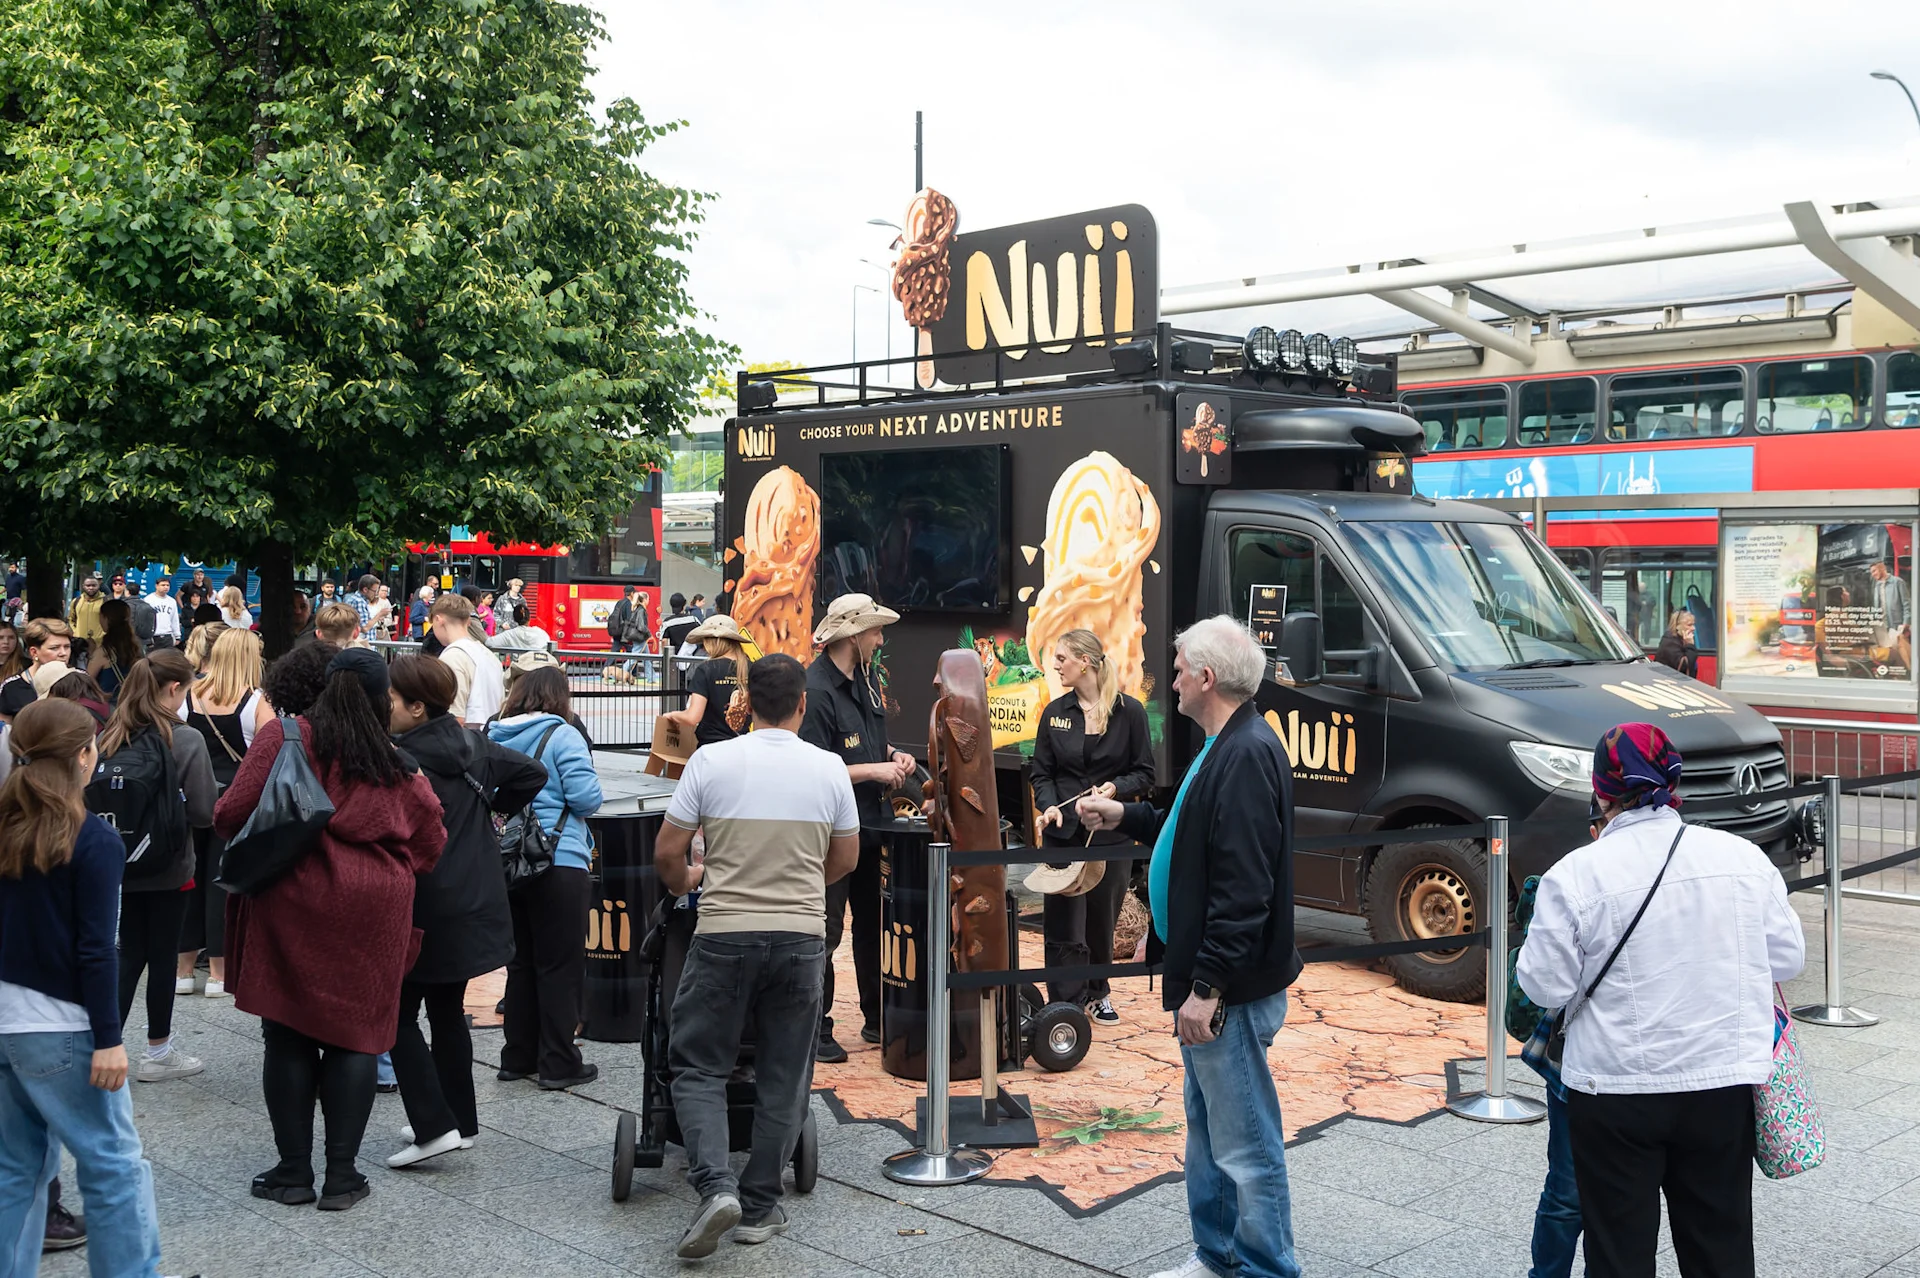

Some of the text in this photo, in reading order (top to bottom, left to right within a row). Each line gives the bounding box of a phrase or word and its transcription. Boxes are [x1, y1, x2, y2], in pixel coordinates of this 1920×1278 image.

[966, 221, 1134, 360] Nuii
[799, 405, 1063, 440] CHOOSE YOUR NEXT ADVENTURE
[738, 424, 776, 457] Nuii
[1865, 533, 1875, 549] 5
[154, 605, 173, 615] NYC
[1600, 678, 1733, 711] Nuii
[1021, 699, 1027, 707] &
[989, 708, 1026, 722] NDIAN
[1050, 716, 1072, 729] Nuii
[990, 721, 1022, 733] MANGO
[1264, 709, 1357, 775] Nuii
[1309, 773, 1348, 784] ADVENTURE
